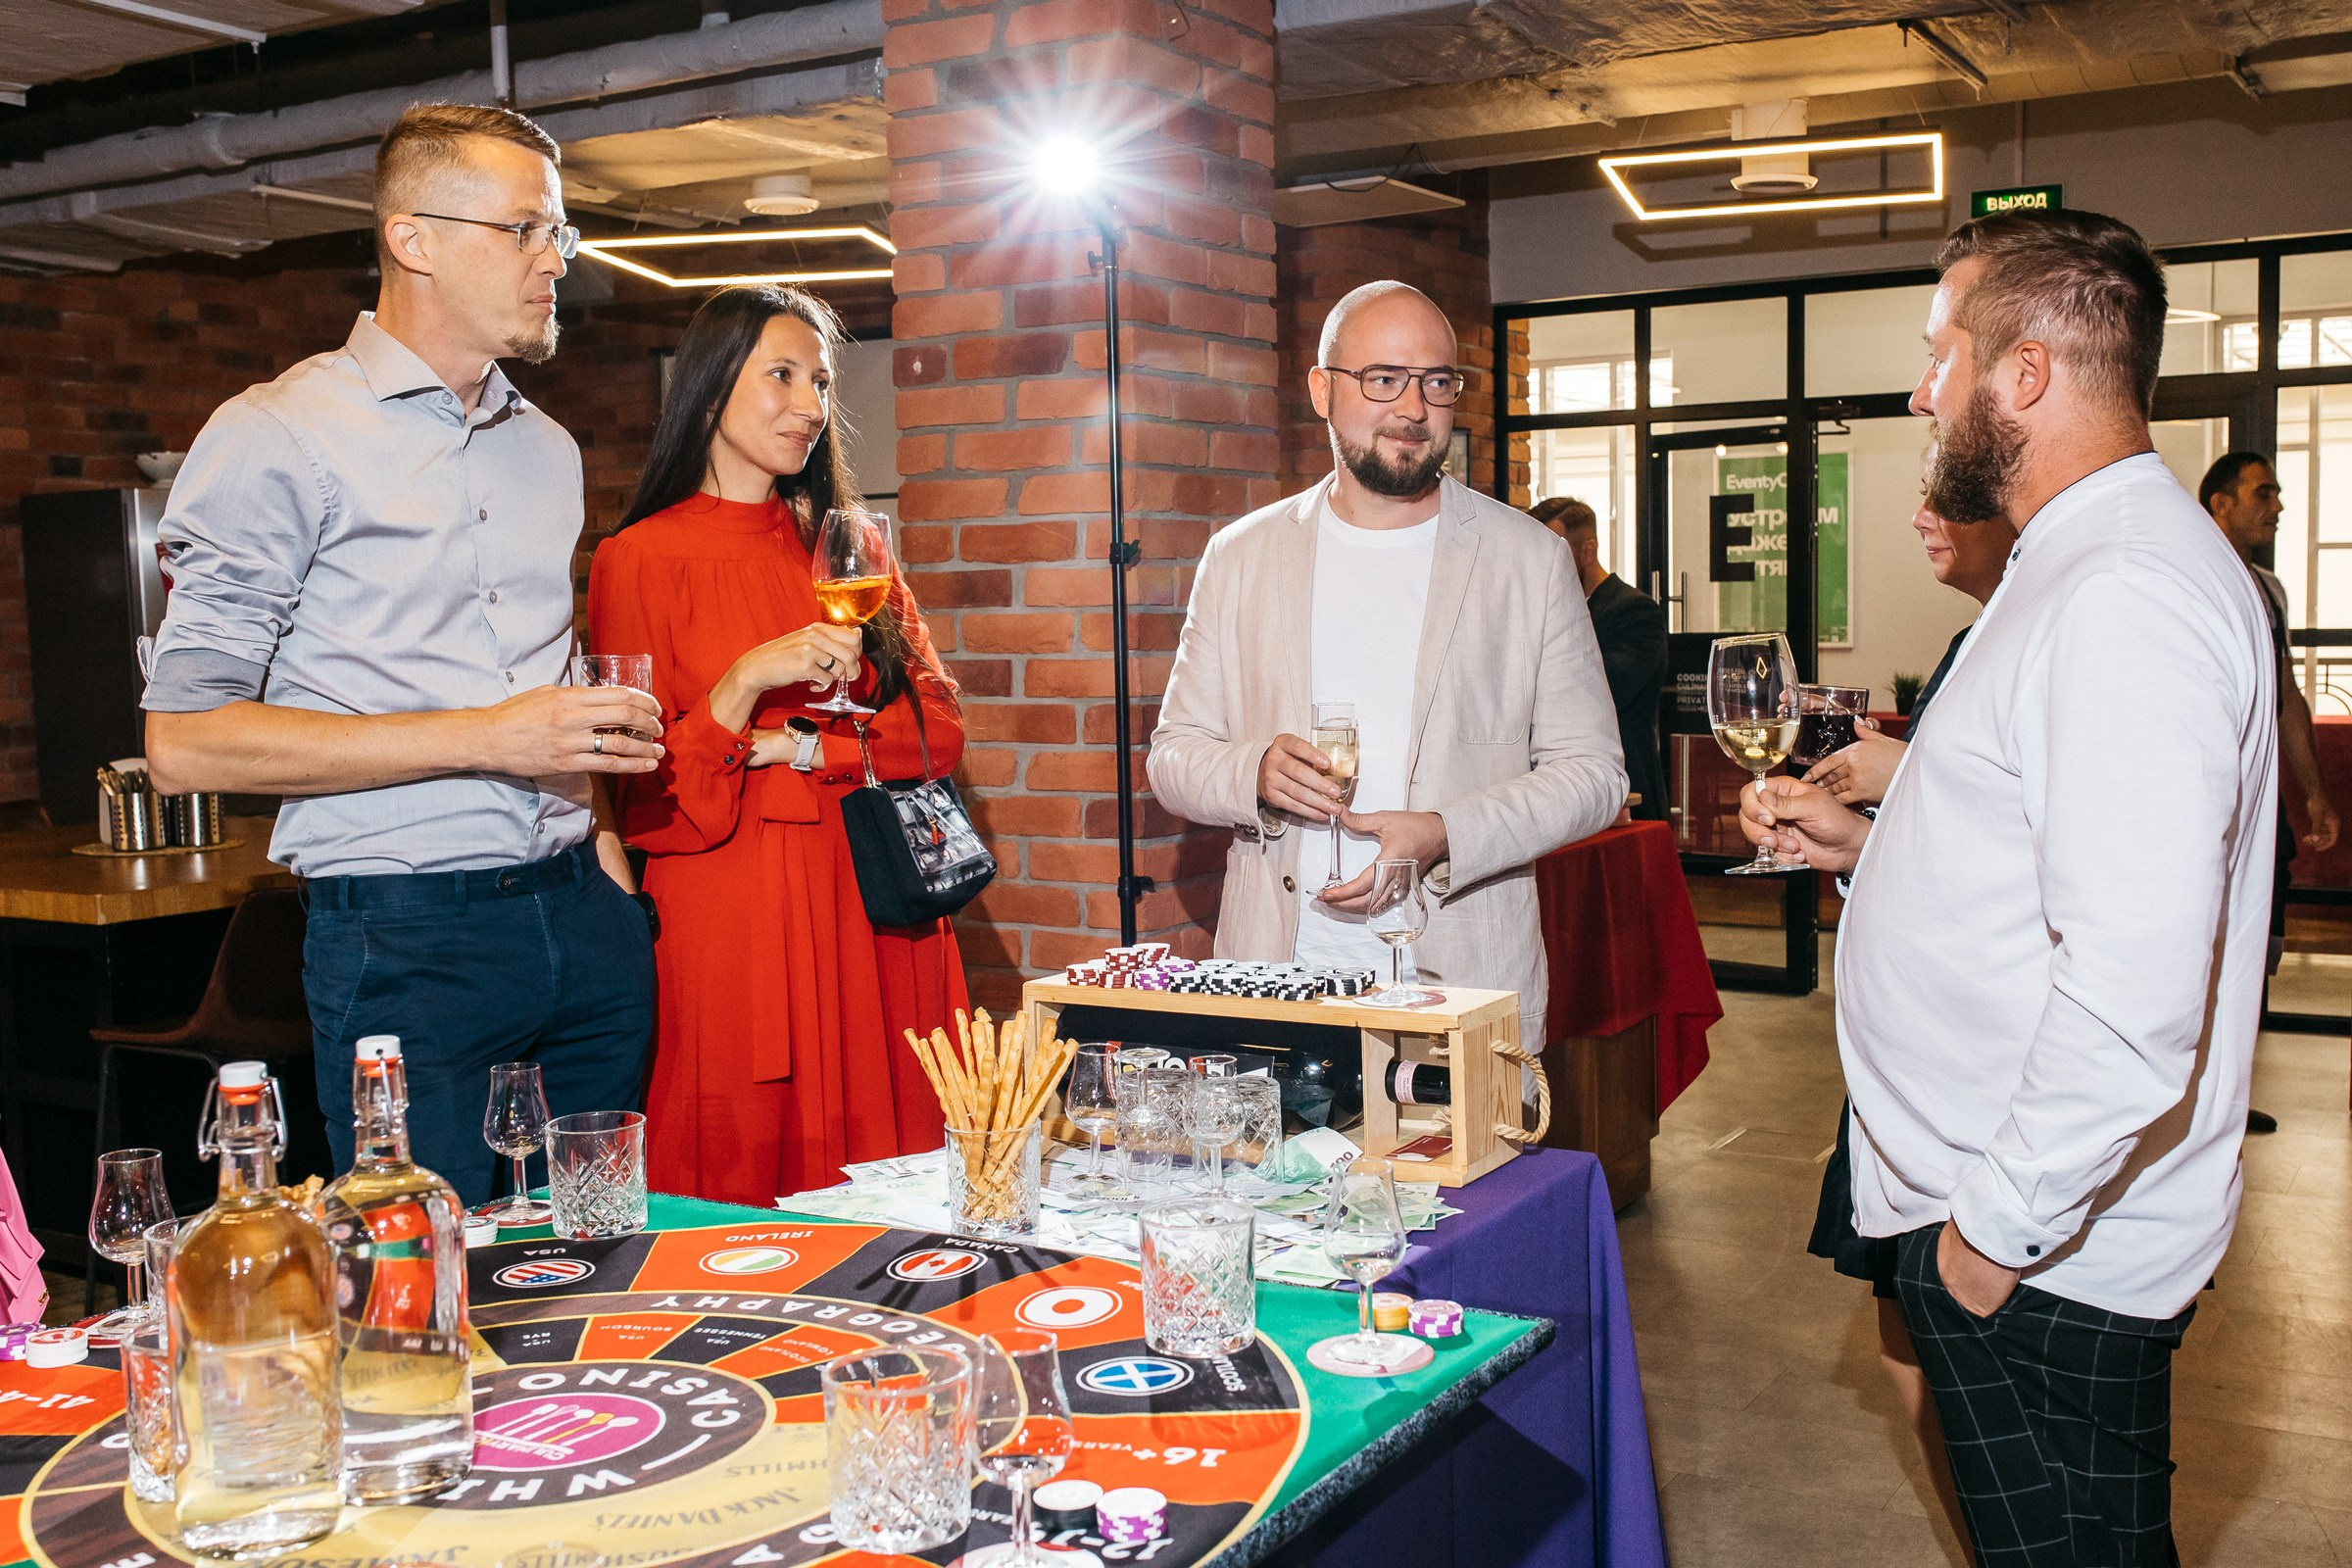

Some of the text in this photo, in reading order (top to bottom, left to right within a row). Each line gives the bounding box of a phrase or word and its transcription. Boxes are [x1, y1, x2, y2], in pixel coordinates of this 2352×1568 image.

[1986, 191, 2047, 212] ВЫХОД
[1727, 507, 1838, 531] устрм
[1676, 673, 1707, 682] COOKI
[1676, 696, 1706, 705] PRIVAT
[723, 1229, 813, 1243] IRELAND
[522, 1248, 566, 1256] USA
[945, 1238, 1020, 1253] CANADA
[600, 1324, 673, 1333] BOURBON
[693, 1326, 767, 1341] TENNESSEE
[759, 1345, 811, 1364] SCOTLAND
[782, 1338, 835, 1356] LOWLAND
[0, 1390, 96, 1409] 41-4
[517, 1368, 741, 1429] CASINO
[1132, 1446, 1227, 1468] 16+
[435, 1469, 636, 1501] WHI
[726, 1485, 805, 1517] JACK
